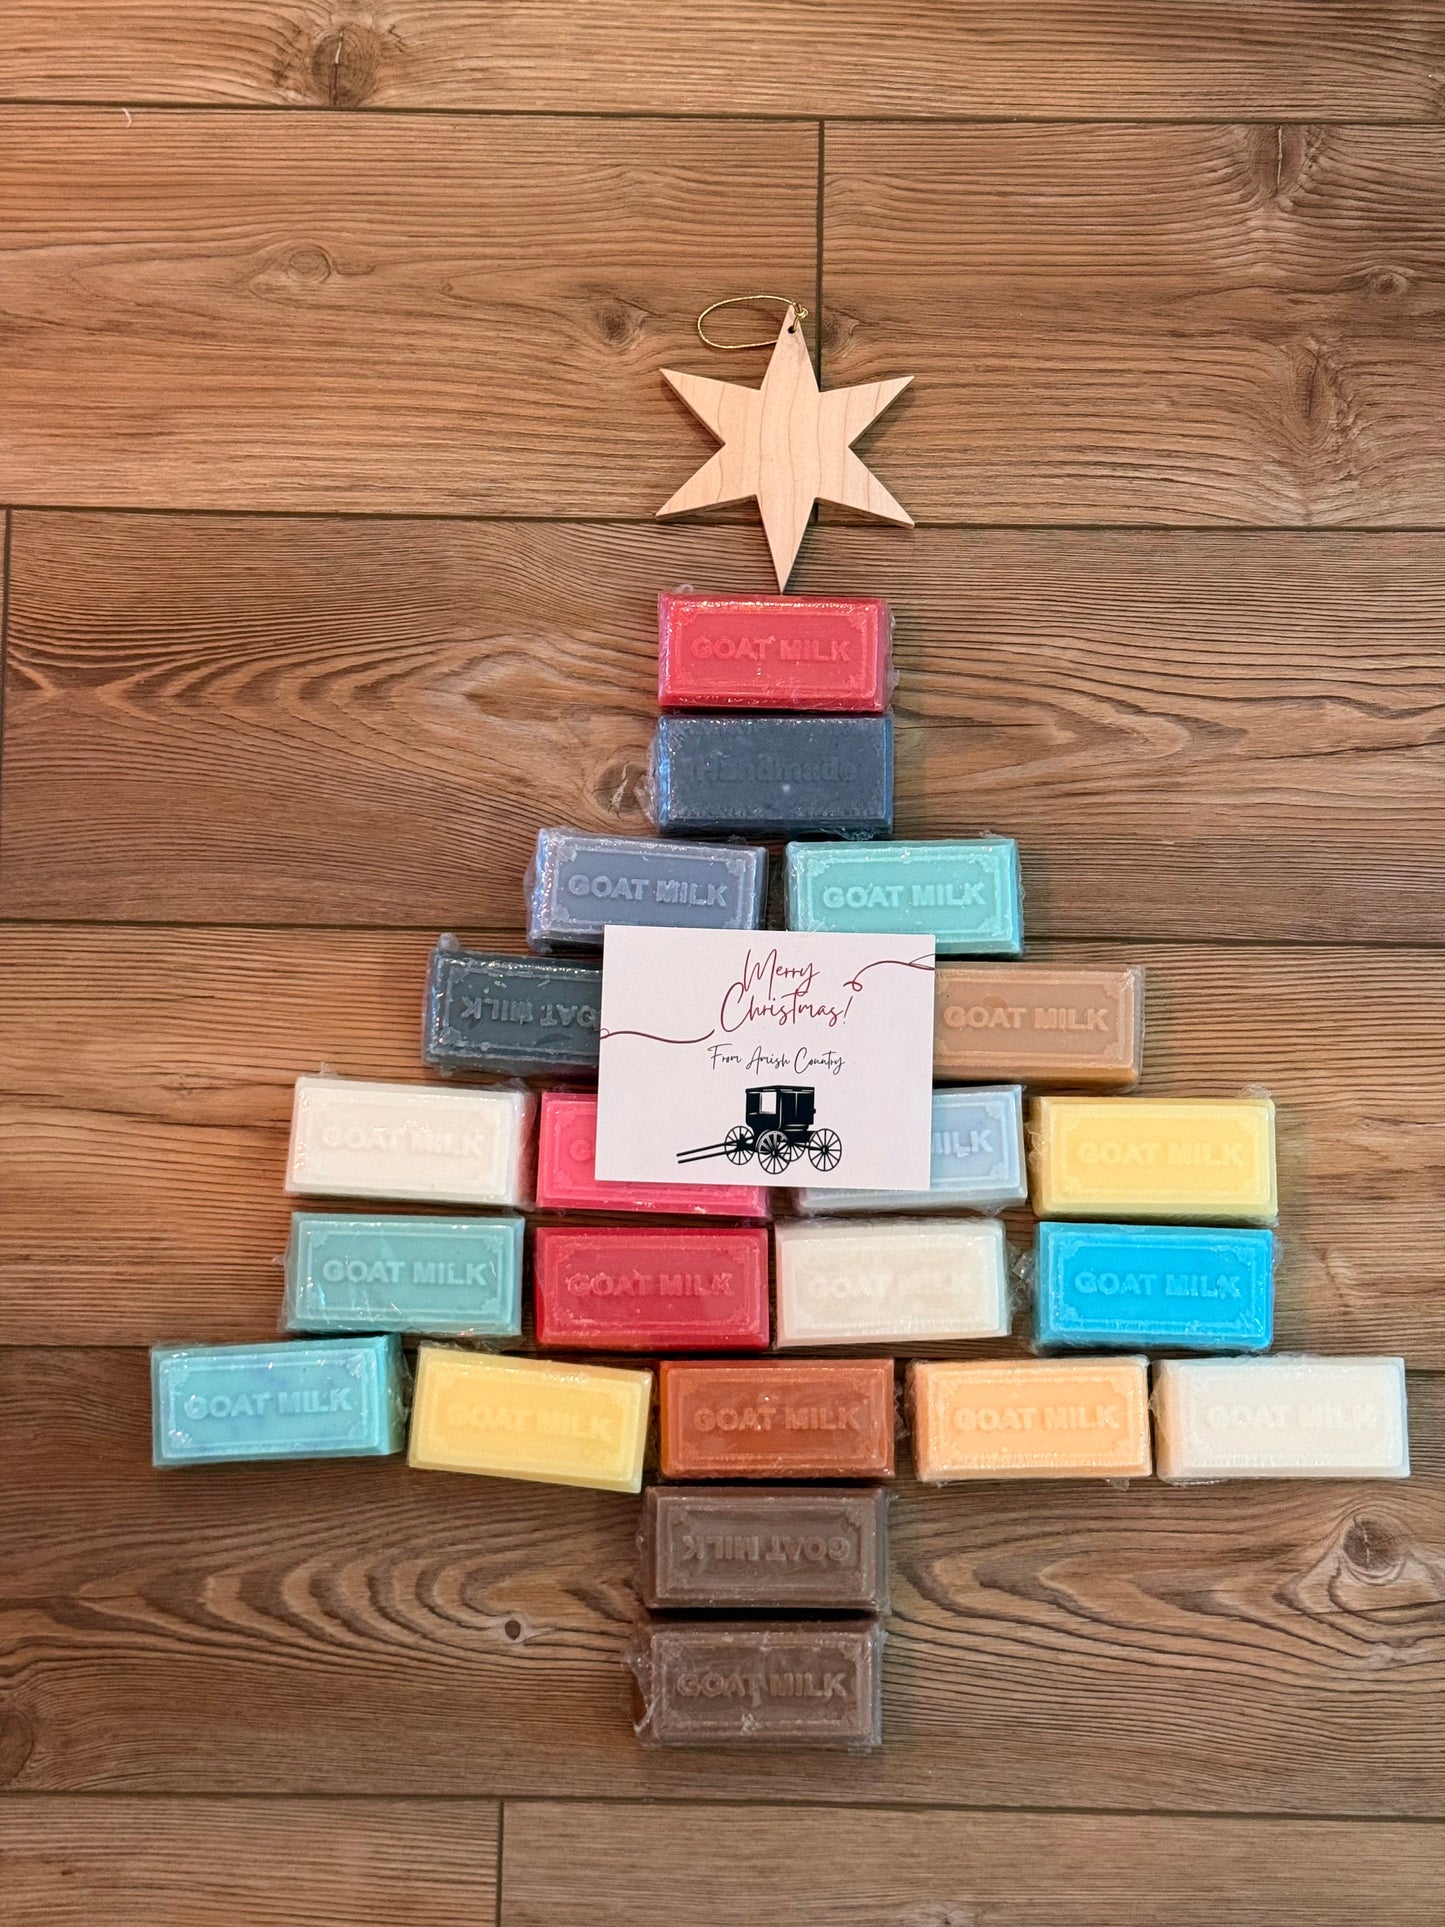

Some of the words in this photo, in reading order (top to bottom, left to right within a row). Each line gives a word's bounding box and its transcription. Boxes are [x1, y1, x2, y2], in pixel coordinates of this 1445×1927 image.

[691, 637, 769, 661] GOAT
[779, 639, 851, 662] MILK
[568, 875, 649, 901] GOAT
[656, 880, 728, 908] MILK
[823, 885, 904, 909] GOAT
[911, 881, 986, 908] MILK
[743, 948, 820, 1001] Merry
[460, 995, 534, 1023] MILK
[540, 1003, 600, 1028] OAT
[720, 981, 853, 1032] Christmas!
[943, 1006, 1027, 1029] GOAT
[1033, 1007, 1110, 1031] MILK
[707, 1043, 742, 1070] From
[793, 1046, 846, 1076] Country
[321, 1126, 405, 1151] GOAT
[410, 1130, 485, 1157] MILK
[1076, 1141, 1160, 1166] GOAT
[1167, 1142, 1244, 1168] MILK
[322, 1259, 406, 1284] GOAT
[412, 1262, 487, 1286] MILK
[567, 1273, 652, 1297] GOAT
[659, 1273, 734, 1297] MILK
[808, 1274, 891, 1299] GOAT
[1074, 1271, 1158, 1296] GOAT
[1165, 1274, 1242, 1300] MILK
[183, 1391, 273, 1421] GOAT
[276, 1386, 354, 1417] MILK
[953, 1406, 1037, 1431] GOAT
[1044, 1404, 1120, 1431] MILK
[1207, 1403, 1290, 1430] GOAT
[1297, 1403, 1378, 1430] MILK
[446, 1403, 534, 1433] GOAT
[536, 1408, 612, 1442] MILK
[693, 1407, 778, 1432] GOAT
[784, 1406, 861, 1431] MILK
[681, 1534, 760, 1562] MILK
[764, 1535, 851, 1562] GOAT
[676, 1672, 764, 1700] GOAT
[768, 1672, 848, 1698] MILK
